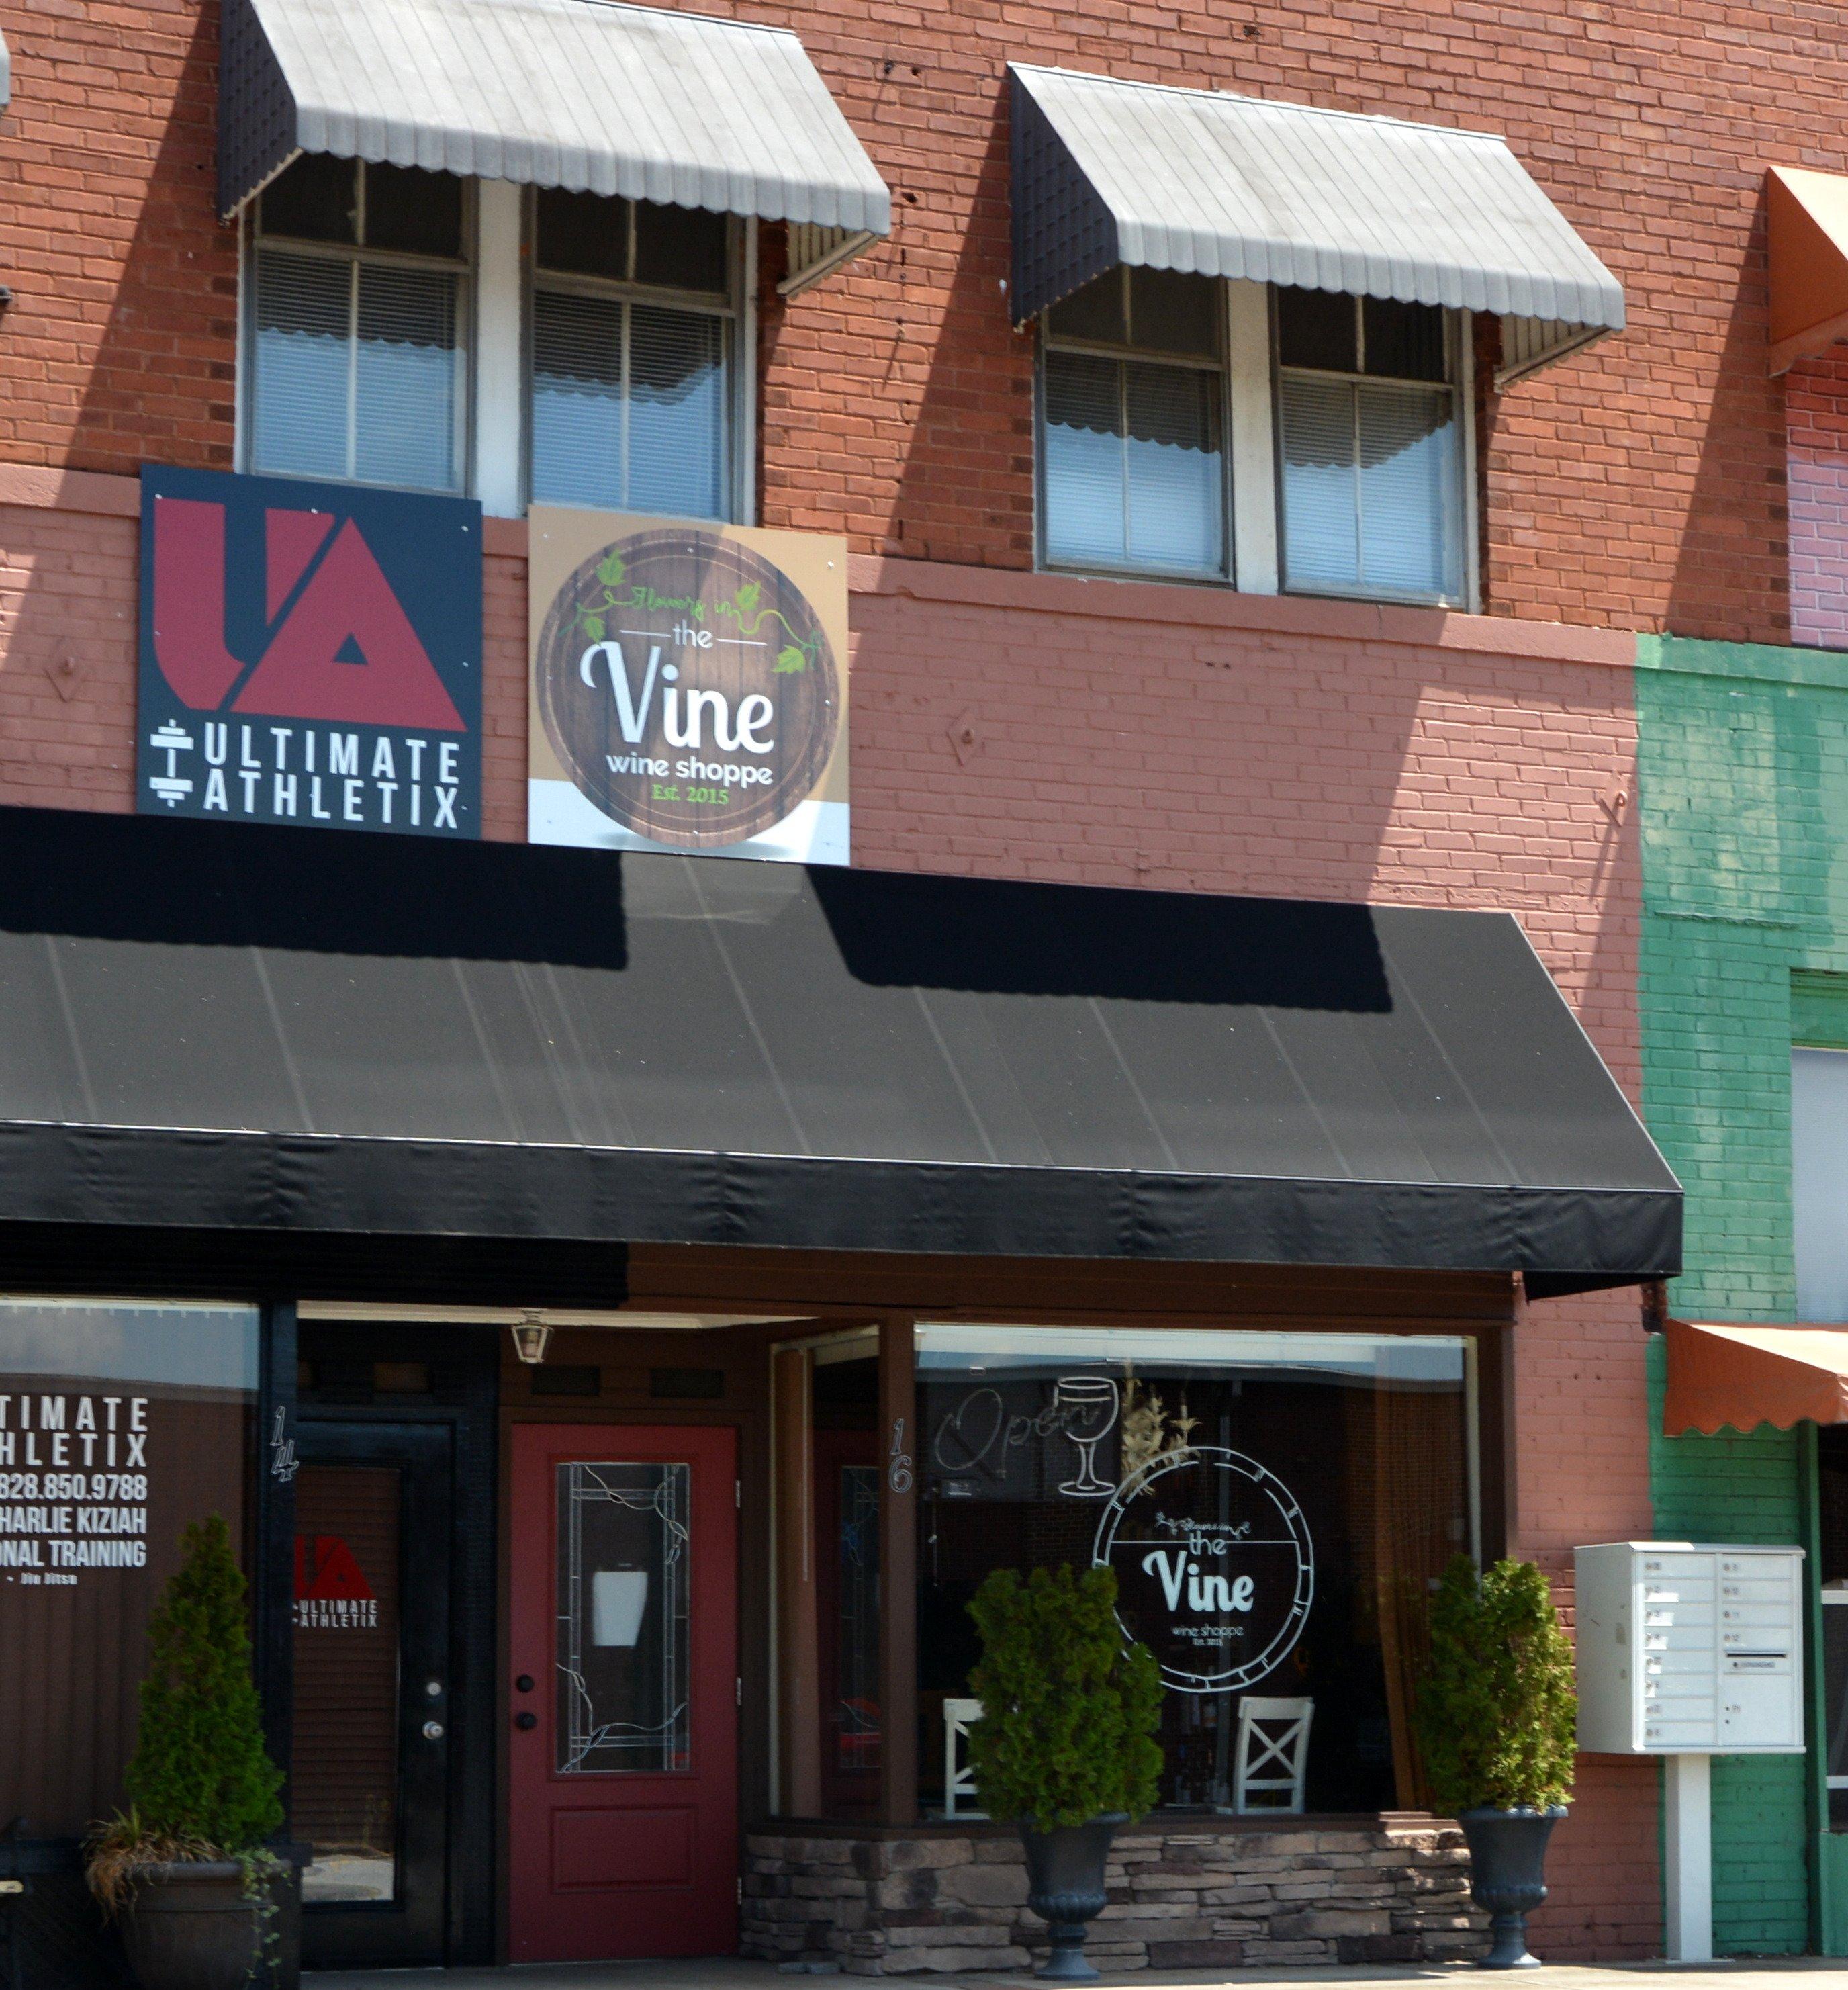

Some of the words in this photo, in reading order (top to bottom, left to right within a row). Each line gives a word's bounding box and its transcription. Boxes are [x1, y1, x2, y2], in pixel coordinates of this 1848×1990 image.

[154, 497, 468, 733] UA
[672, 619, 714, 649] the
[579, 640, 774, 754] Vine
[204, 721, 460, 784] ULTIMATE
[605, 751, 670, 778] wine
[674, 755, 774, 789] shoppe
[203, 768, 459, 829] ATHLETIX
[686, 786, 730, 805] 2015
[0, 1472, 148, 1501] 828.850.9788
[76, 1506, 147, 1534] KIZIAH
[0, 1539, 45, 1567] NAL
[48, 1540, 147, 1568] TRAINING
[1189, 1530, 1228, 1555] the
[1142, 1549, 1254, 1613] Vine
[299, 1600, 377, 1615] ULTIMATE
[299, 1614, 377, 1628] ATHLETIX
